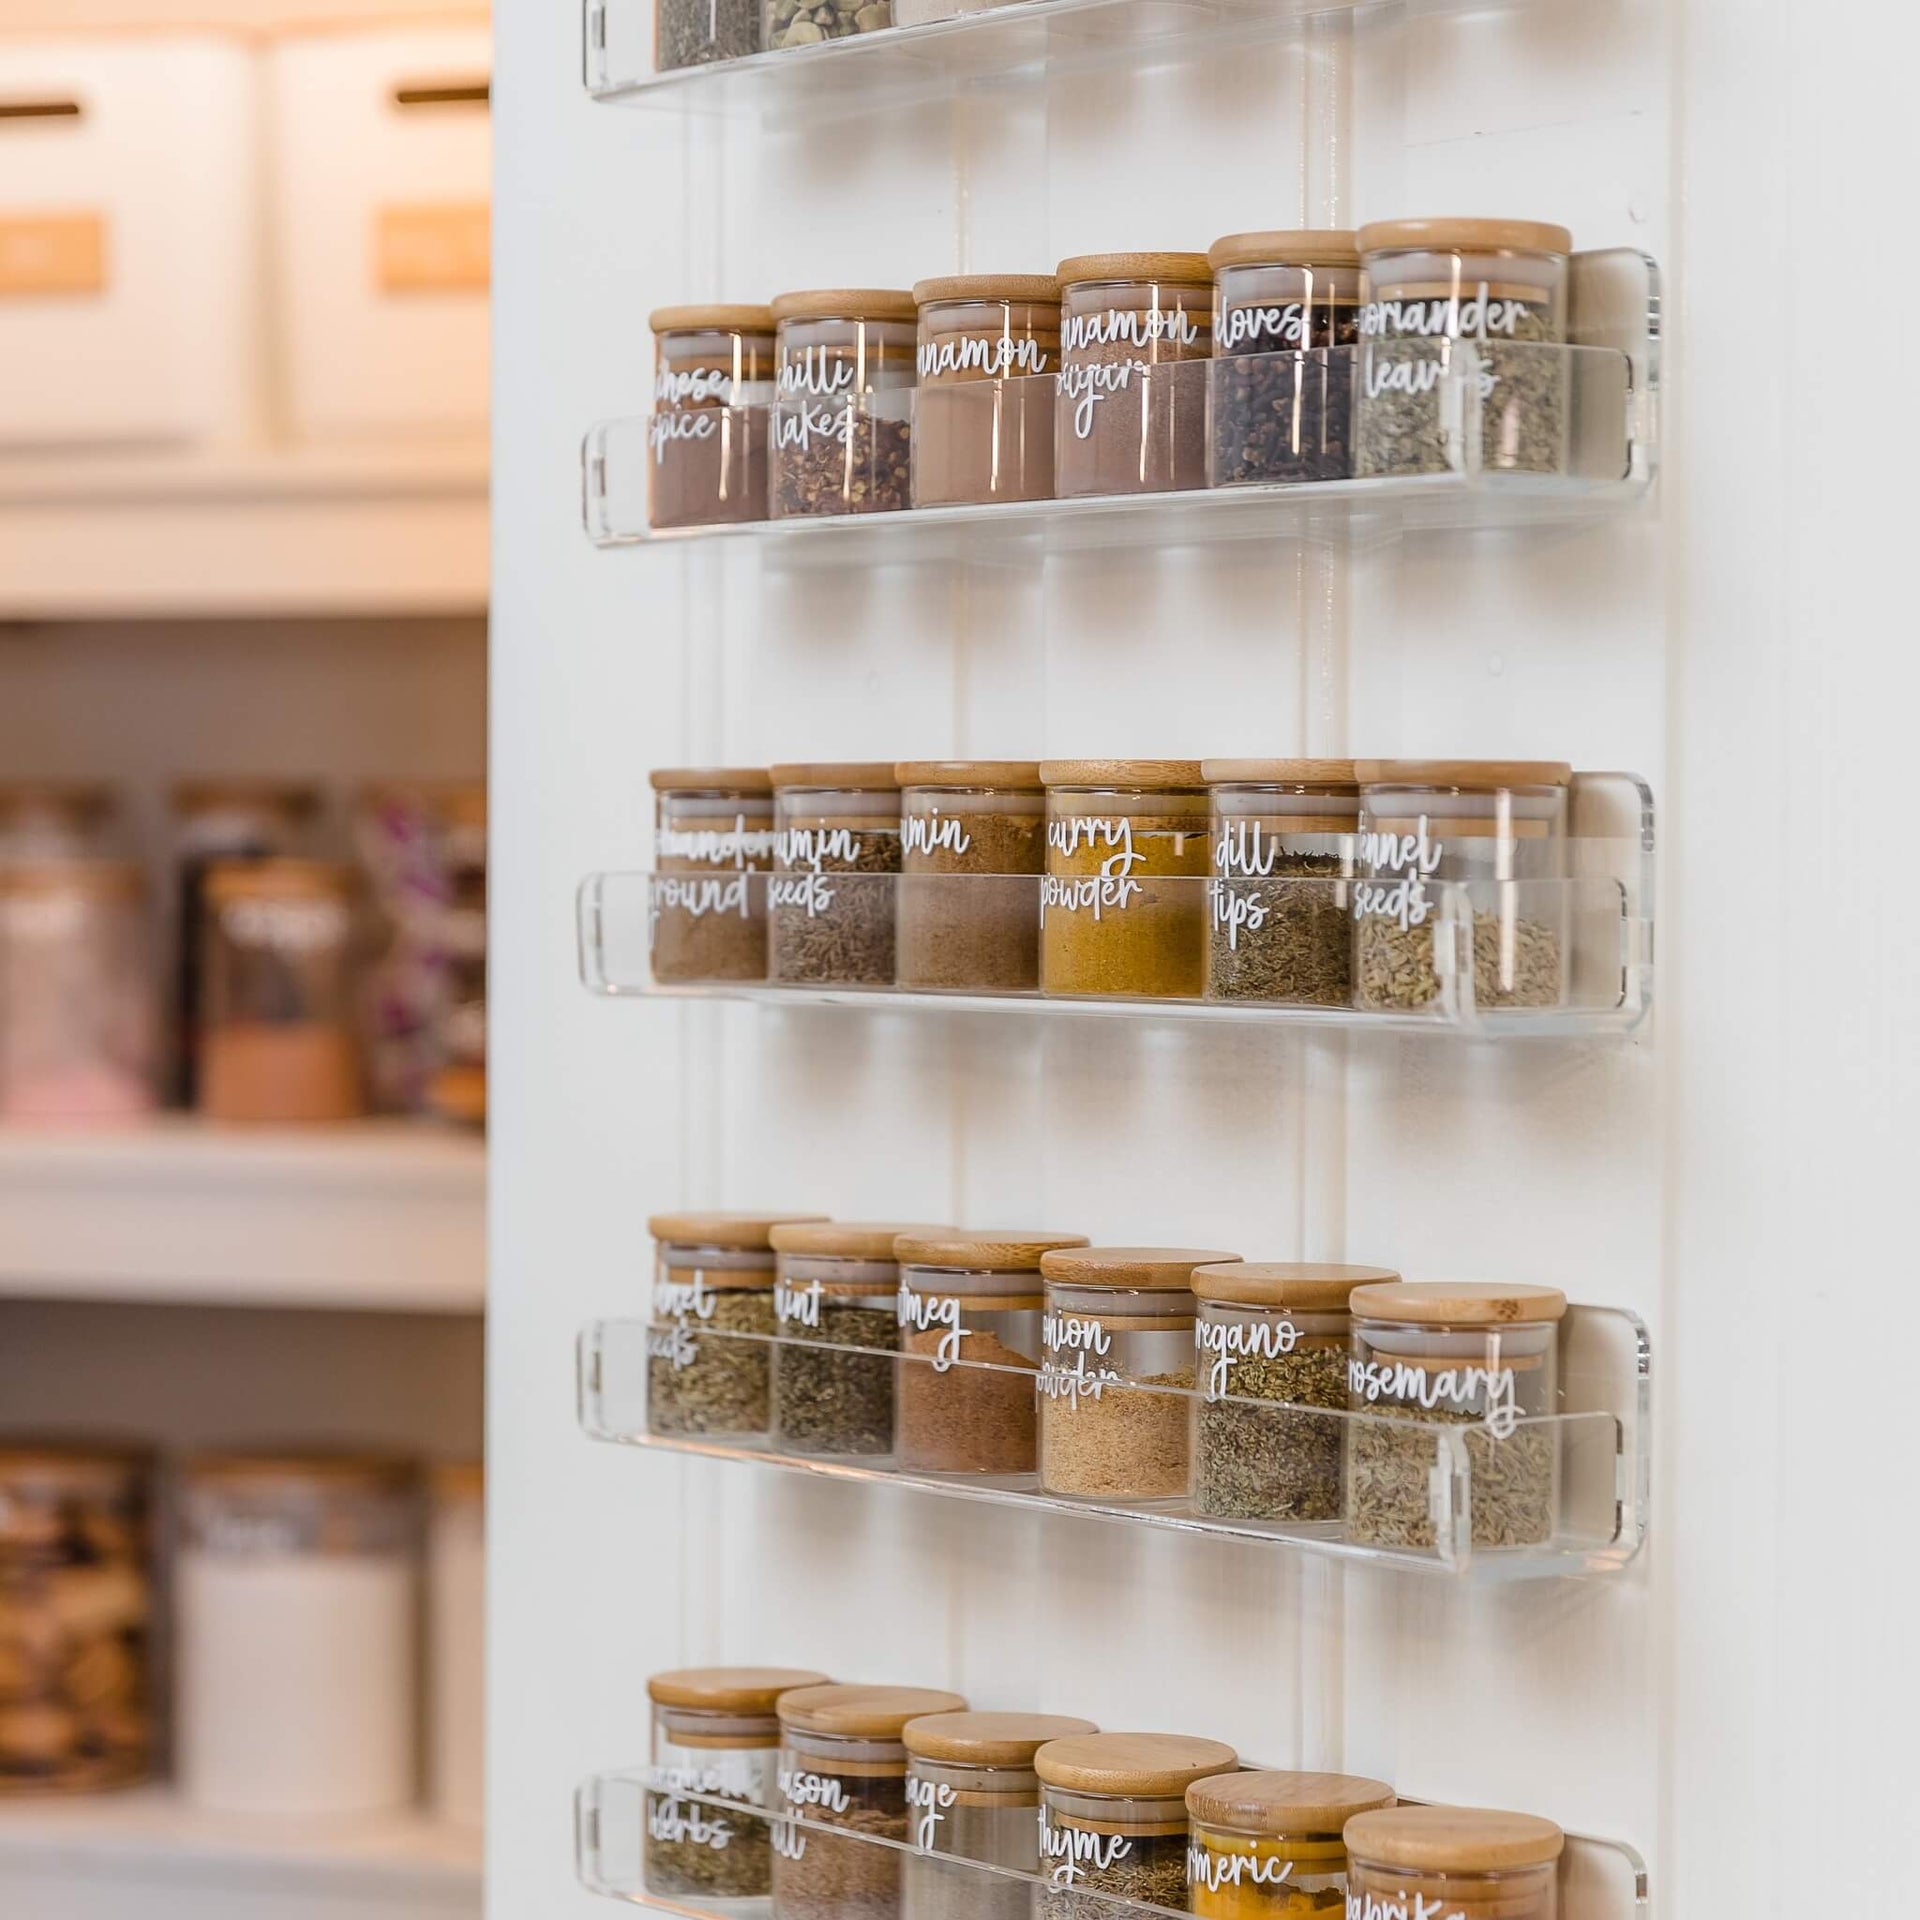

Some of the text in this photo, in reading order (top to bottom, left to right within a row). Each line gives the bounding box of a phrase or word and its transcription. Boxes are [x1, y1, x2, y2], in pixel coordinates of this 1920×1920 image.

[1216, 820, 1275, 878] dill
[1210, 879, 1270, 950] tips
[1195, 1318, 1305, 1402] regano
[1187, 1840, 1294, 1893] rmeric
